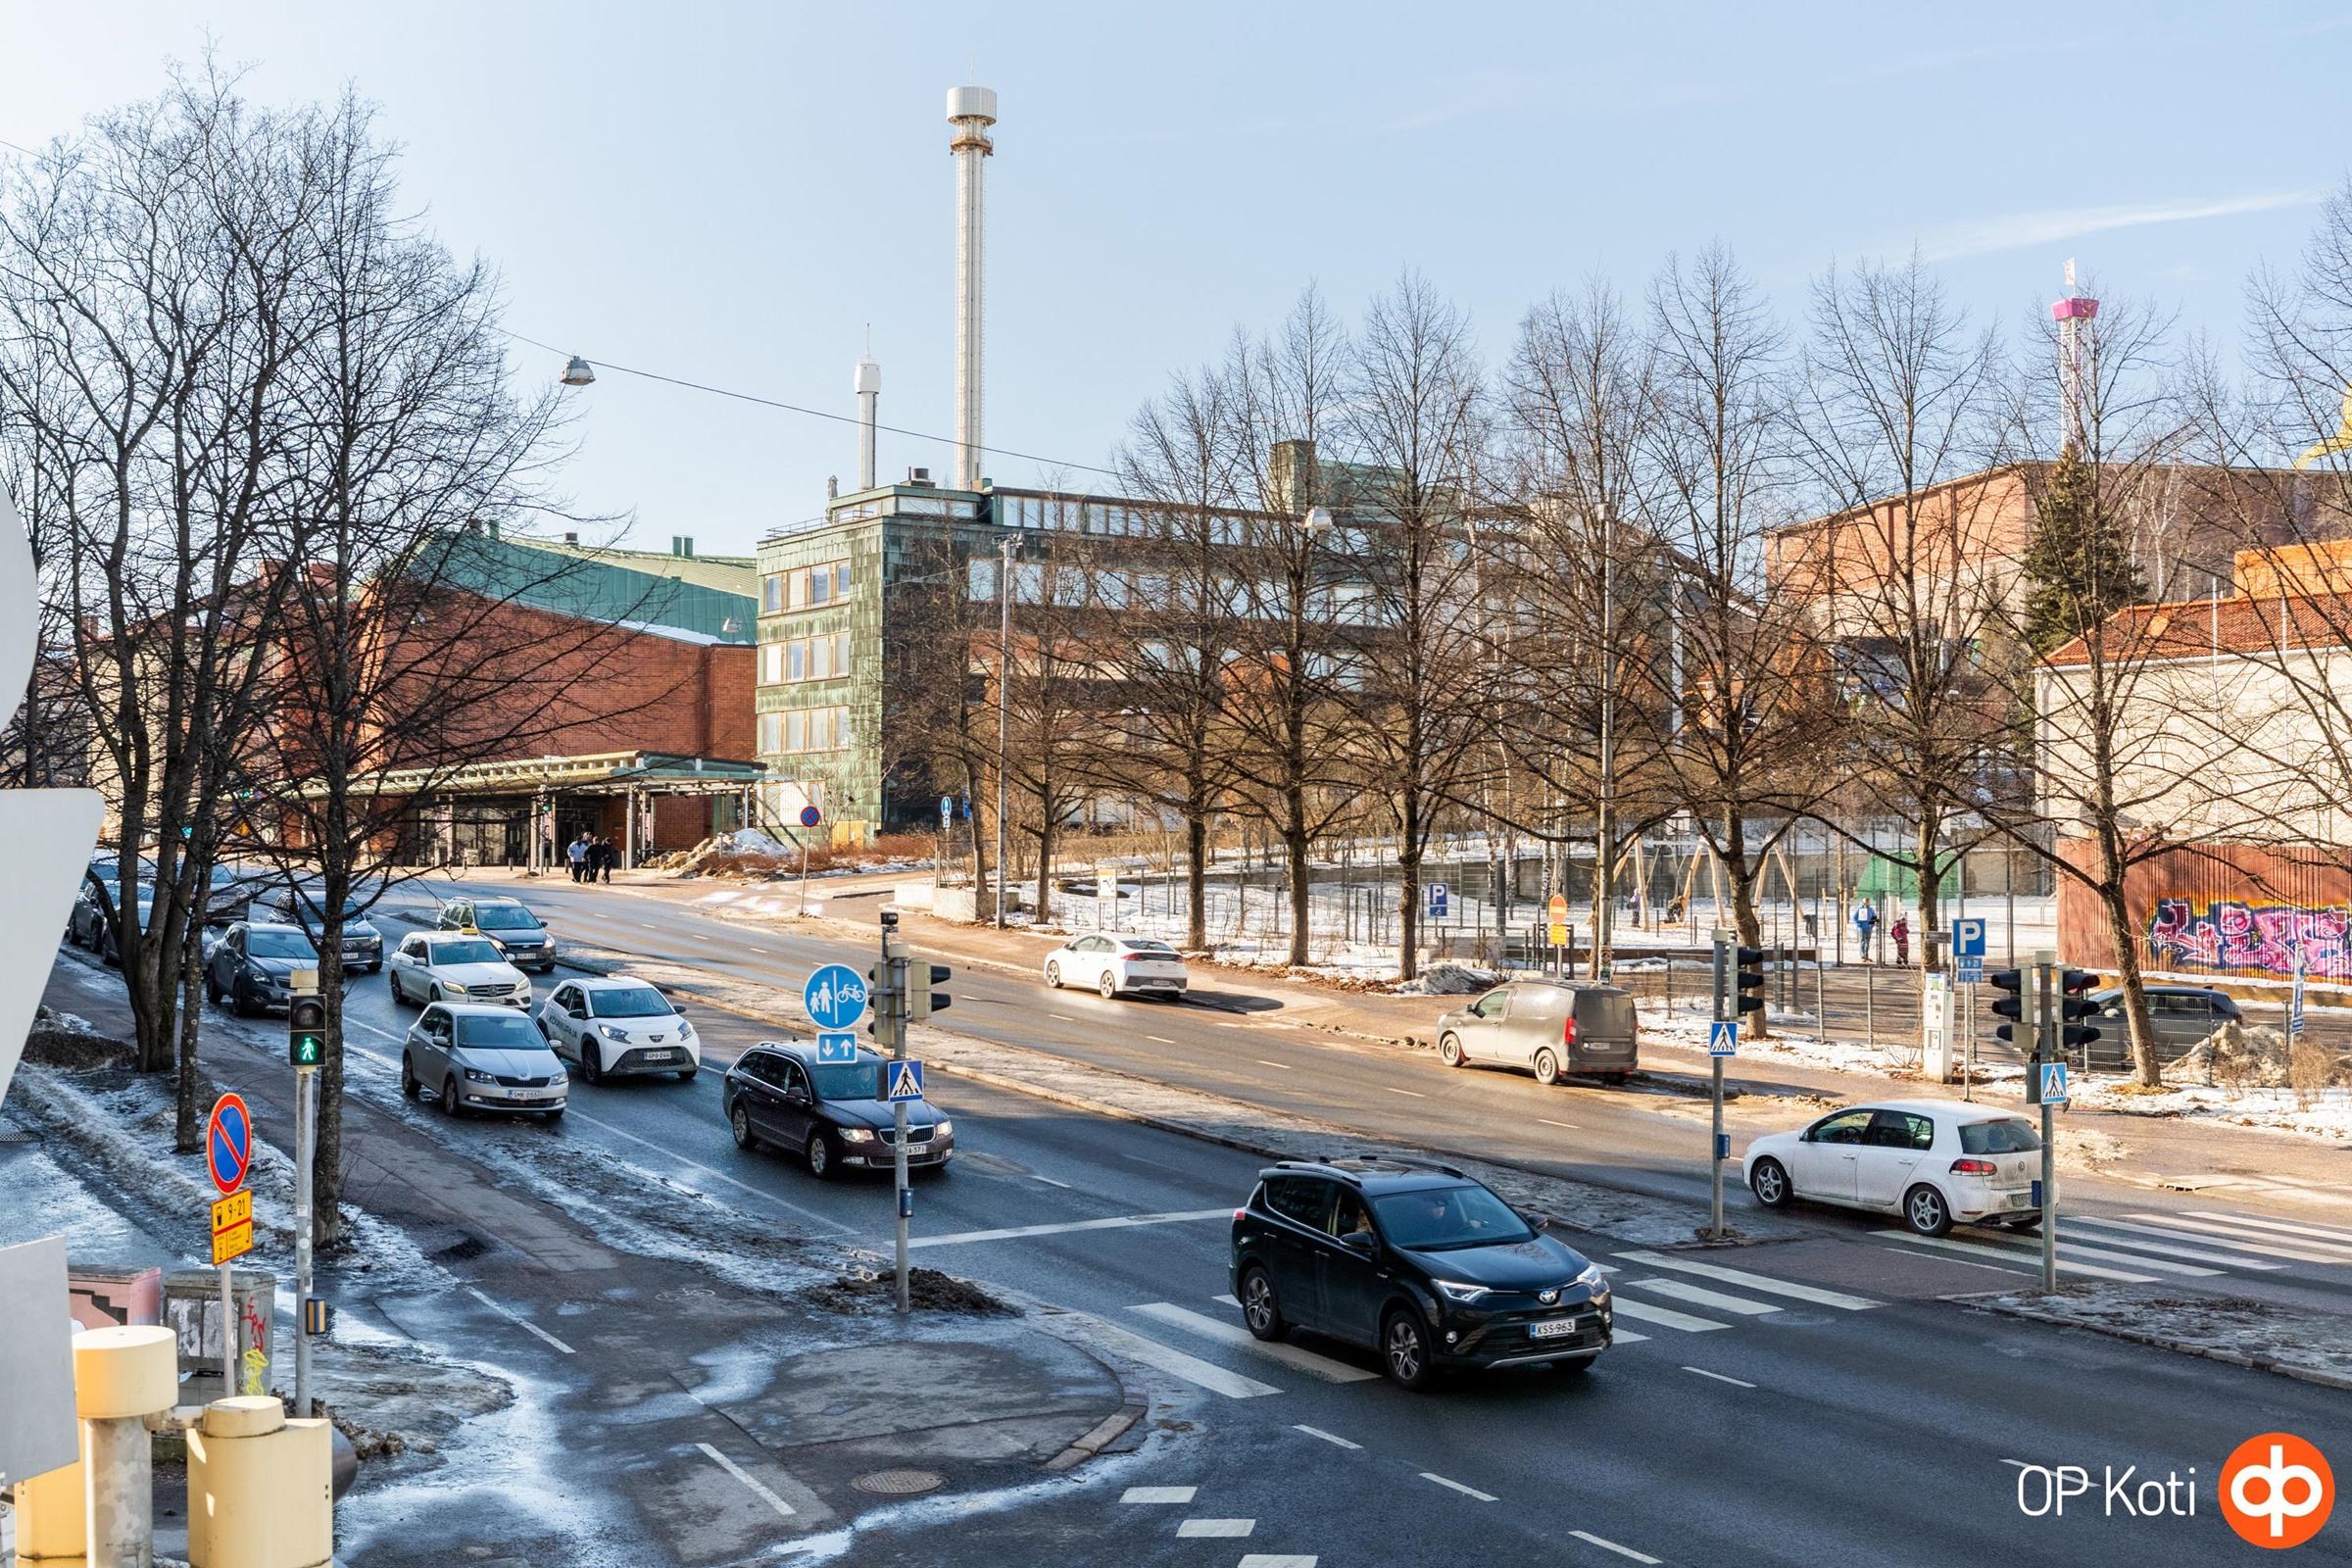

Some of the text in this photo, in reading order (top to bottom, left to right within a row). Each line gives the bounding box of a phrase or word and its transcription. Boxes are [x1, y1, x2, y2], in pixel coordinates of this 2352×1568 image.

[1433, 885, 1446, 904] P
[1959, 921, 1981, 955] P
[1537, 1322, 1574, 1335] KSS-963
